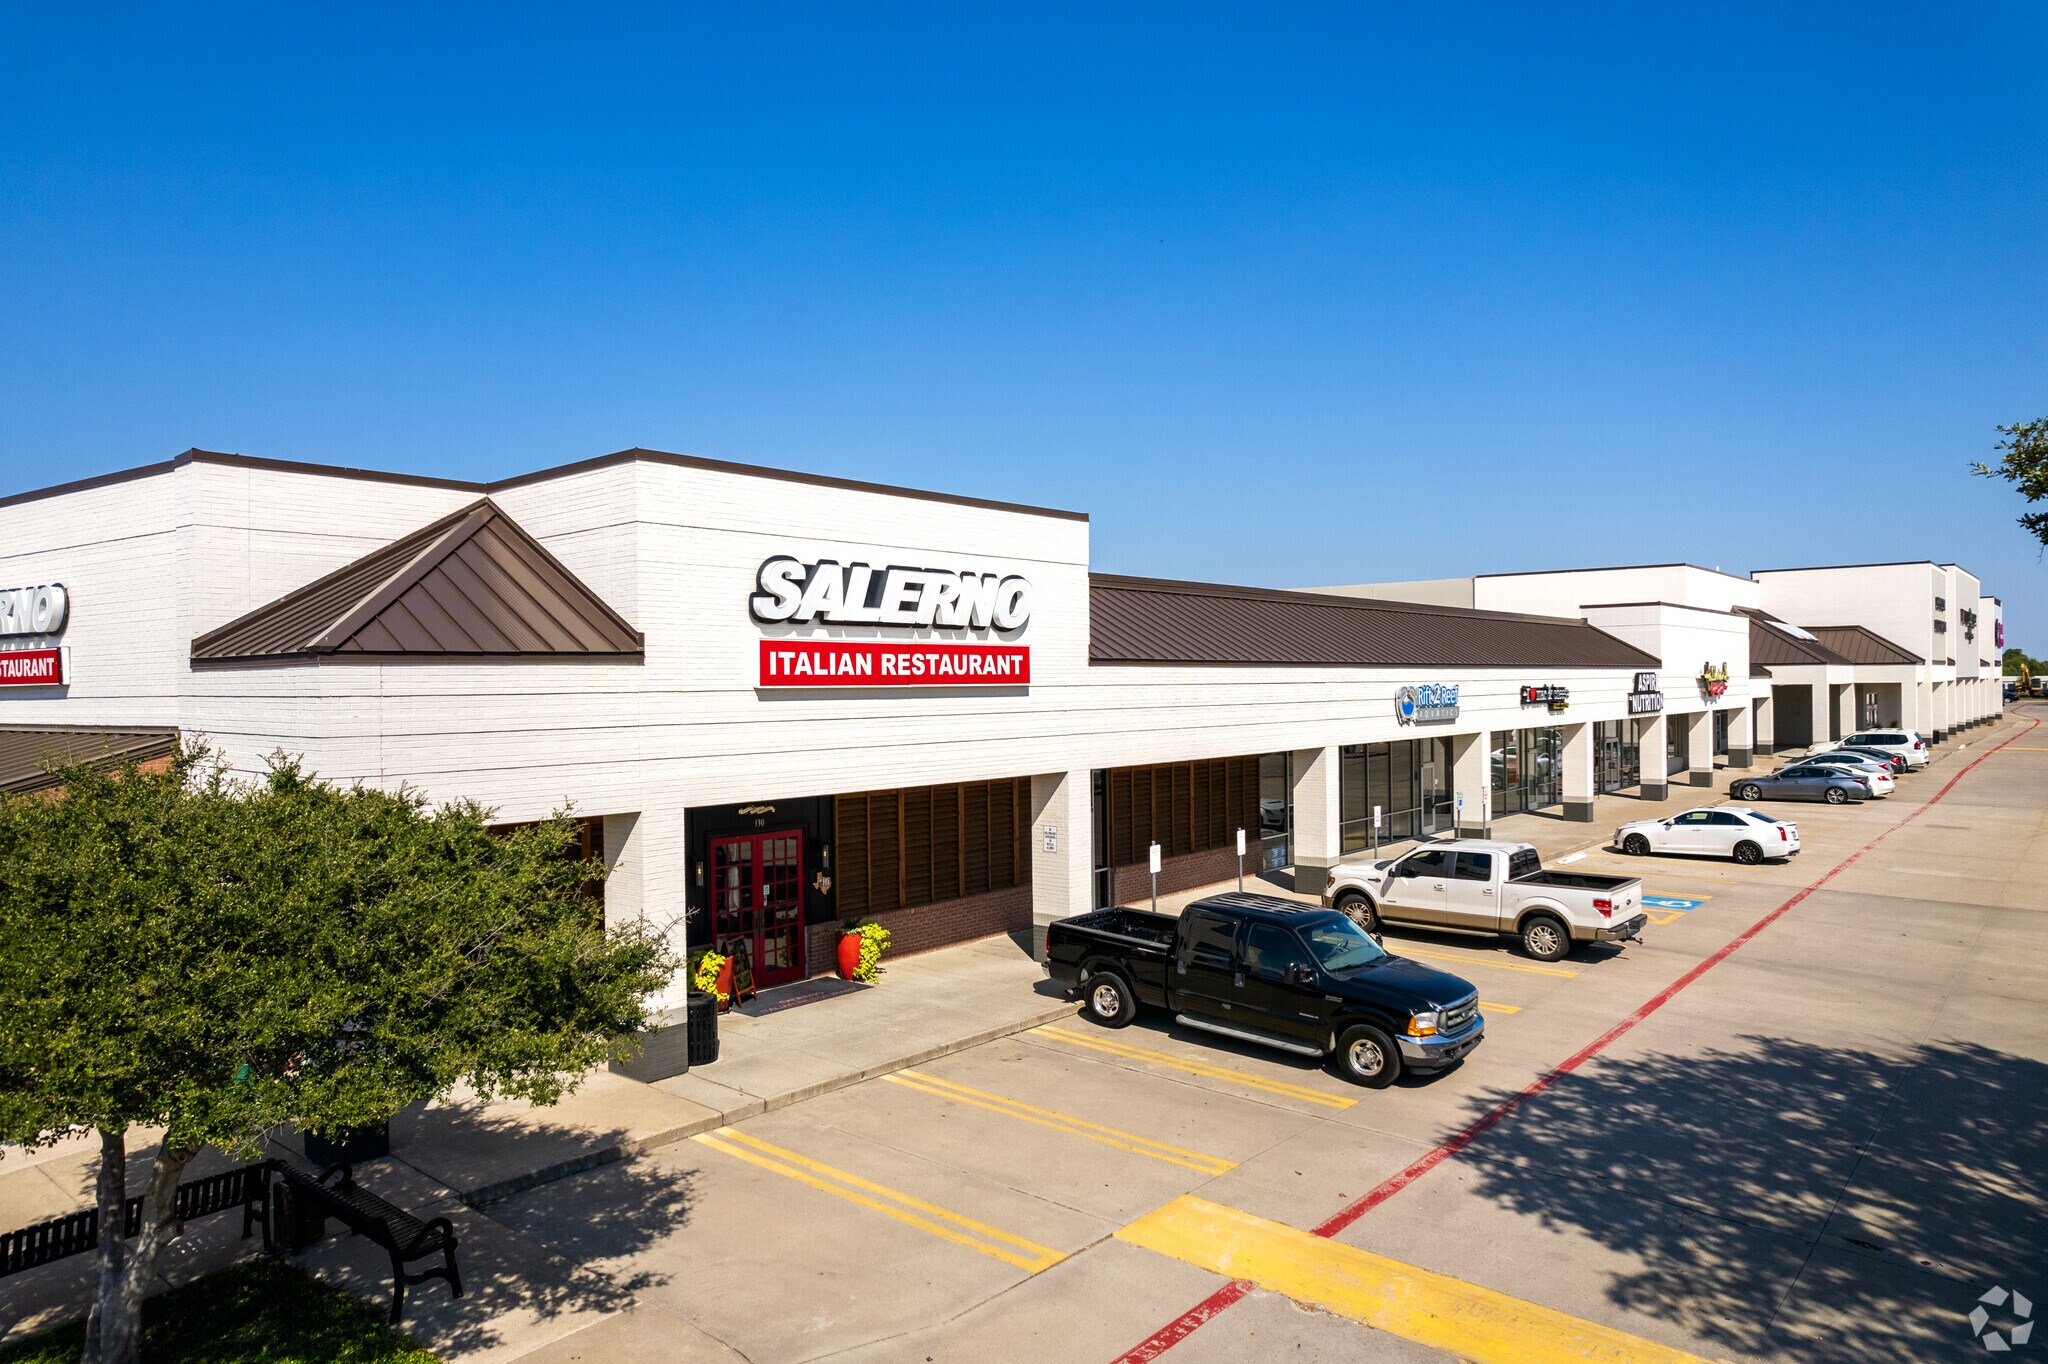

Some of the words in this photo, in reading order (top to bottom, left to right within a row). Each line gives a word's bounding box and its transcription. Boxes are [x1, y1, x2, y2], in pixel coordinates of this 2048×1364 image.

[752, 557, 1033, 630] SALERNO
[769, 651, 872, 676] ITALIAN
[881, 653, 1023, 675] RESTAURANT
[1418, 686, 1432, 706] Rift
[1433, 684, 1441, 704] 2
[1441, 686, 1459, 704] Reef
[1632, 694, 1664, 713] NUTRITION
[754, 819, 765, 827] 130
